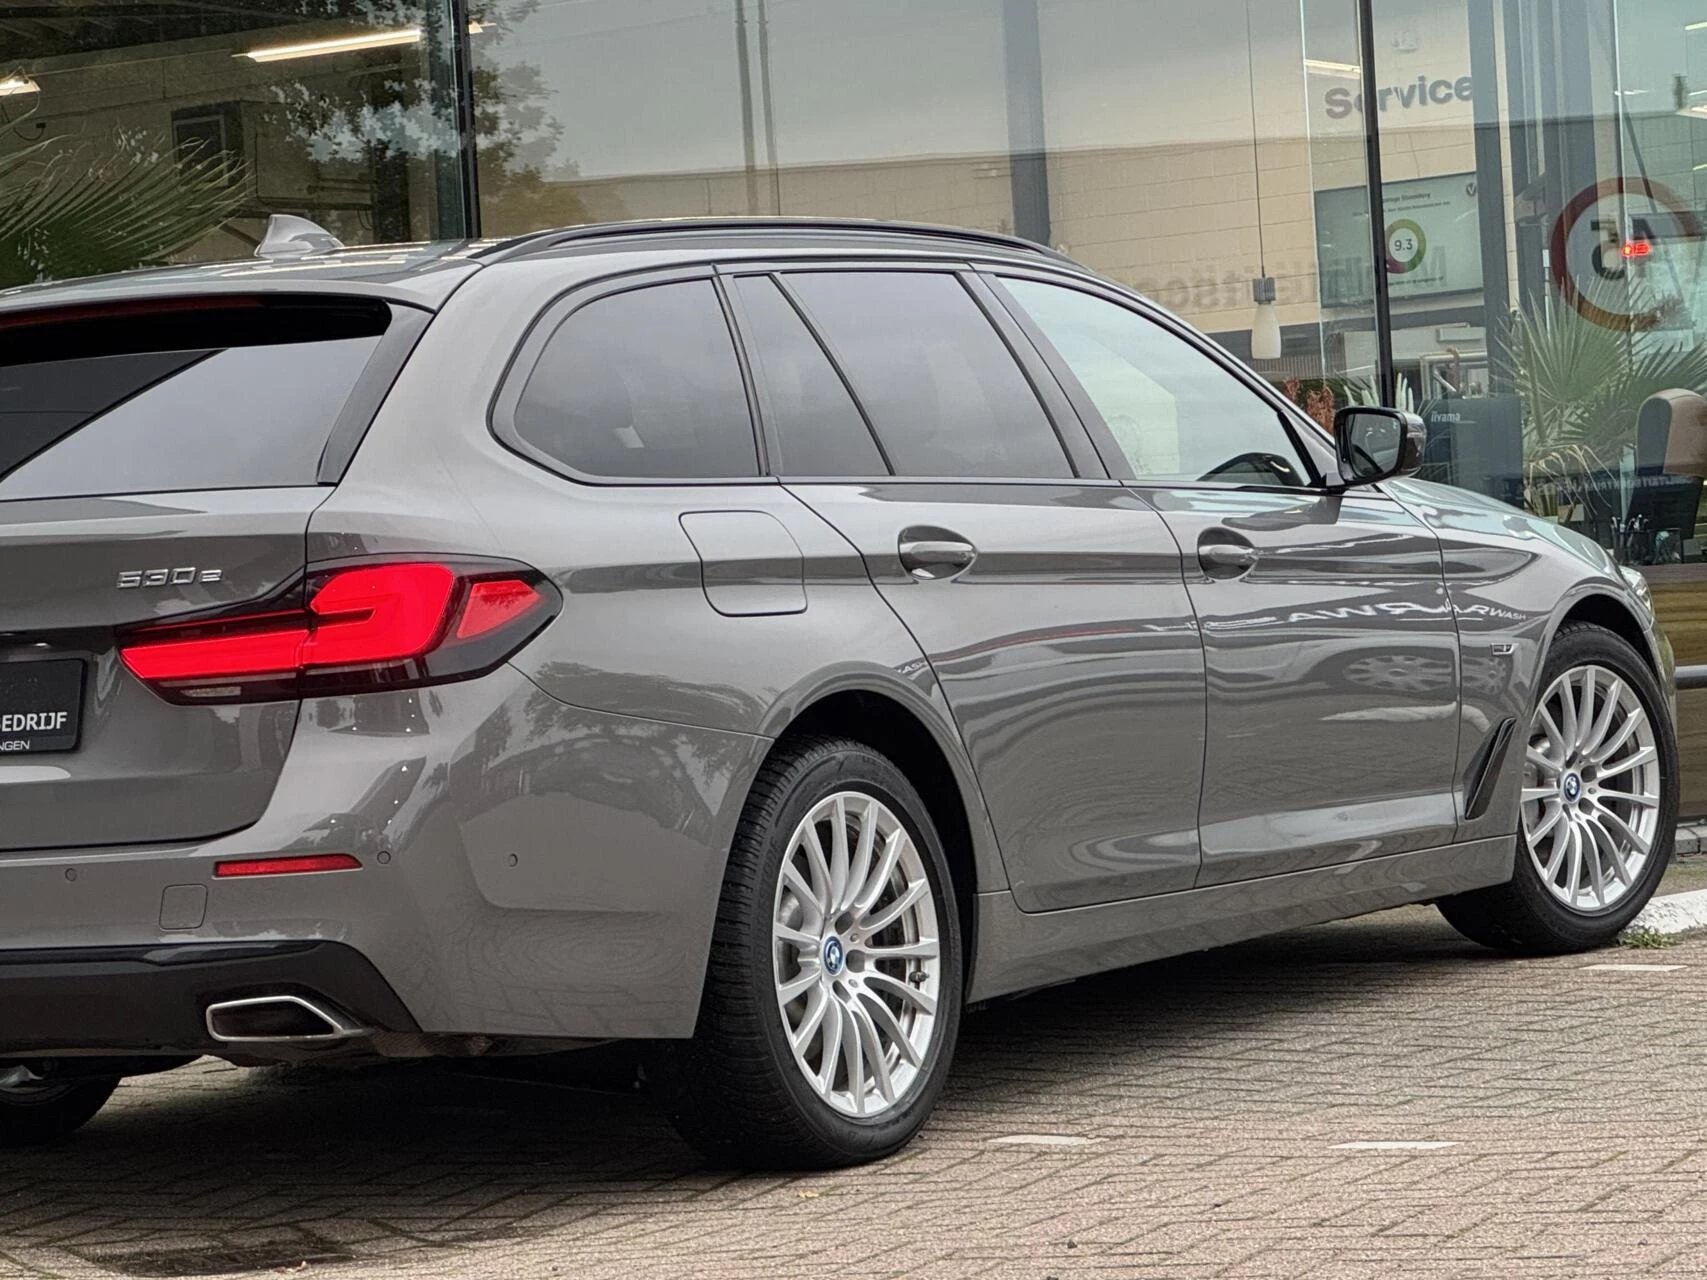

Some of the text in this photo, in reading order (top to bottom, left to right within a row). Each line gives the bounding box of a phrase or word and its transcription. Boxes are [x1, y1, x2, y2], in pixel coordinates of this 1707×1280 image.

[1394, 238, 1413, 252] 9.3
[117, 567, 222, 589] 530e
[0, 711, 68, 732] EDRIJF
